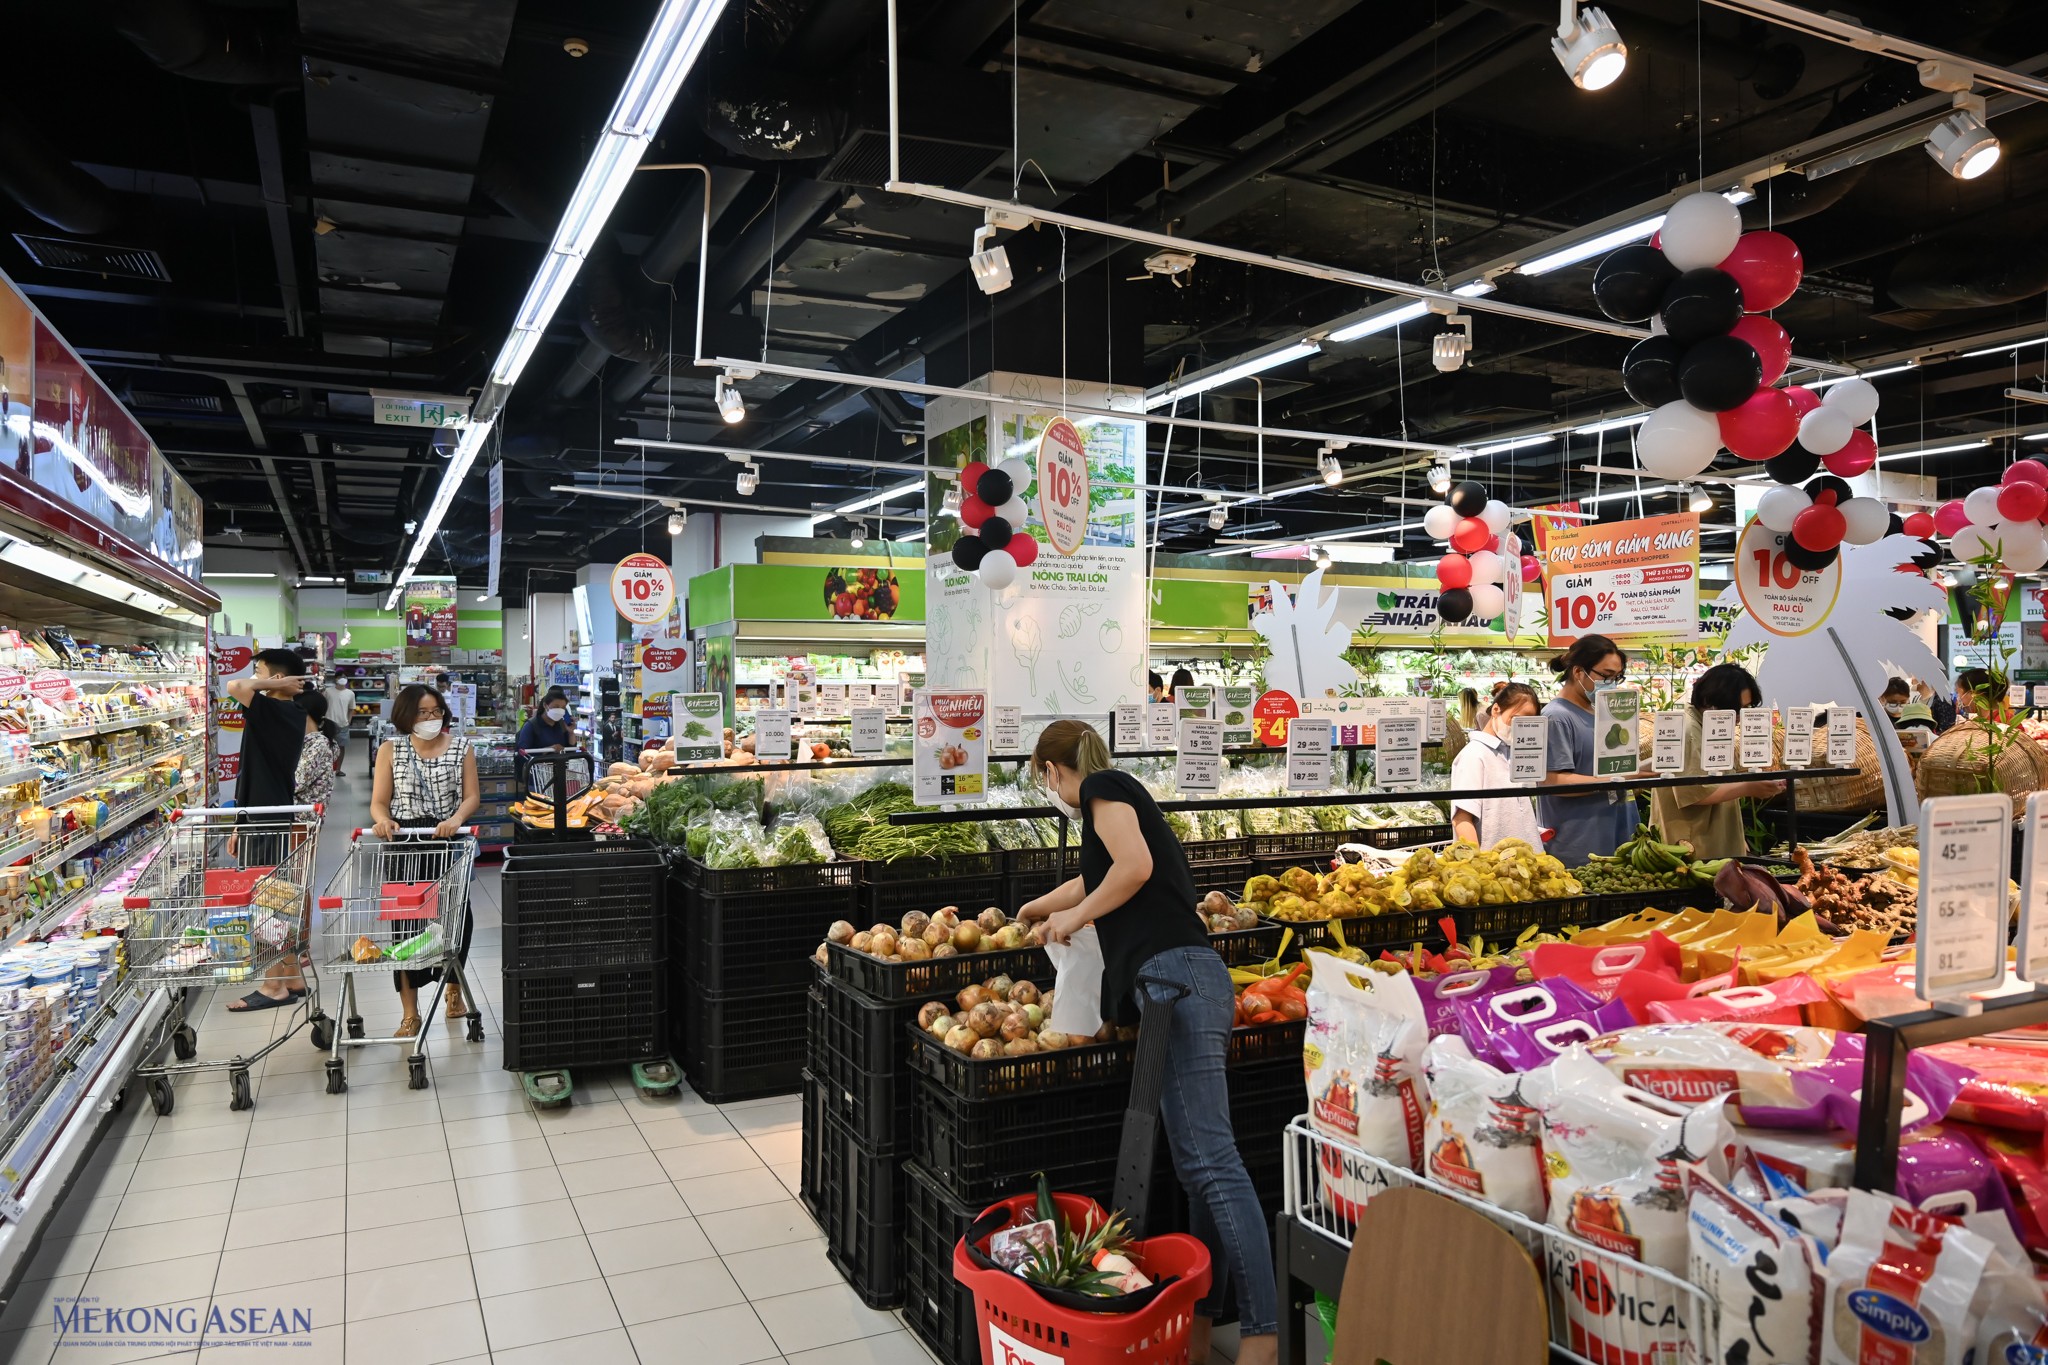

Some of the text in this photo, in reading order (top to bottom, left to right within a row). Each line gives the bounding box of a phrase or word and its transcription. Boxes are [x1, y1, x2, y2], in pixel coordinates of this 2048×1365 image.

[386, 414, 411, 422] EXIT
[1058, 450, 1073, 468] GIẢM
[1048, 461, 1082, 508] 10%
[1070, 496, 1079, 506] OFF
[1056, 520, 1065, 531] RAU
[1550, 528, 1695, 564] CHỢ SỚM GIẢM SUNG
[1583, 560, 1610, 568] DISCOUNT
[634, 569, 652, 578] GIẢM
[1032, 569, 1107, 585] NÔNG TRẠI LỚN
[1802, 575, 1819, 584] OFF
[1565, 575, 1592, 589] GIẢM
[621, 579, 664, 601] 10%
[1620, 586, 1681, 599] TOÀN BỘ SẢN PHẨM
[1779, 594, 1787, 602] BỘ
[1787, 594, 1798, 602] SẢN
[1798, 595, 1813, 603] PHẨM
[1554, 591, 1617, 630] 10%
[1773, 602, 1804, 613] RAU CỦ
[1382, 609, 1437, 630] NHẬP
[1597, 613, 1613, 622] OFF
[650, 662, 672, 670] 50%
[34, 680, 66, 688] EXCLUSIVE
[1269, 717, 1286, 740] 4
[1228, 734, 1237, 742] 36
[1388, 737, 1393, 745] 8
[690, 749, 702, 759] 35
[1609, 761, 1620, 772] 17
[1941, 843, 1957, 861] 45
[1938, 901, 1955, 918] 65
[1938, 953, 1953, 970] 81
[1628, 1073, 1730, 1099] Neptune
[1315, 1100, 1357, 1131] Neptune
[1855, 1295, 1924, 1339] Simply
